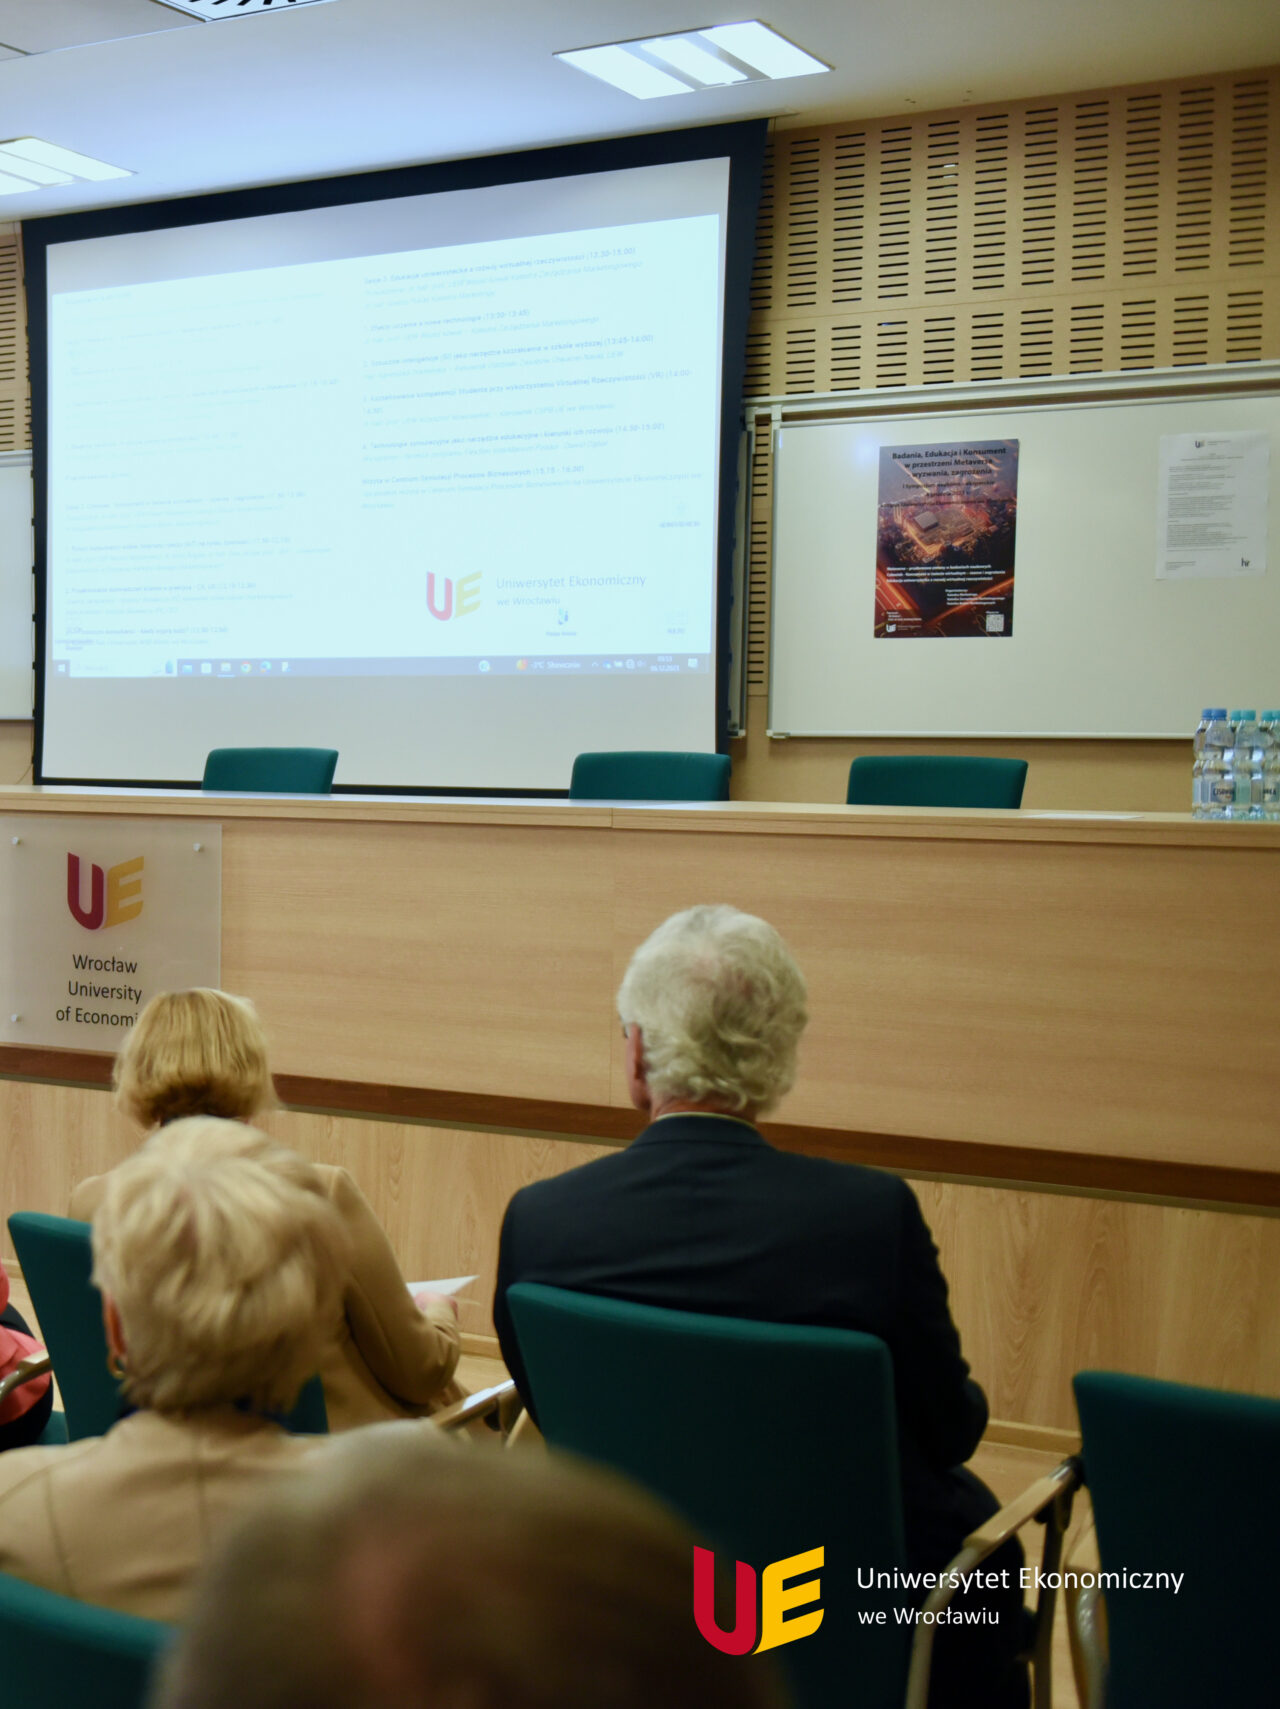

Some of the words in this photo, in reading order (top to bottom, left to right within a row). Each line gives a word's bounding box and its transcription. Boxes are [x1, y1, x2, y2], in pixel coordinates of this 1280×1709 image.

[925, 449, 957, 459] Edukacja
[963, 447, 1006, 456] Konsument
[912, 460, 952, 469] przestrzeni
[496, 576, 565, 590] Uniwersytet
[569, 573, 647, 588] Ekonomiczny
[496, 598, 510, 606] we
[512, 595, 561, 606] Wrocławiu
[67, 852, 144, 930] UE
[73, 954, 138, 974] Wrocław
[68, 981, 142, 1004] University
[56, 1007, 70, 1021] of
[76, 1008, 138, 1027] Economi
